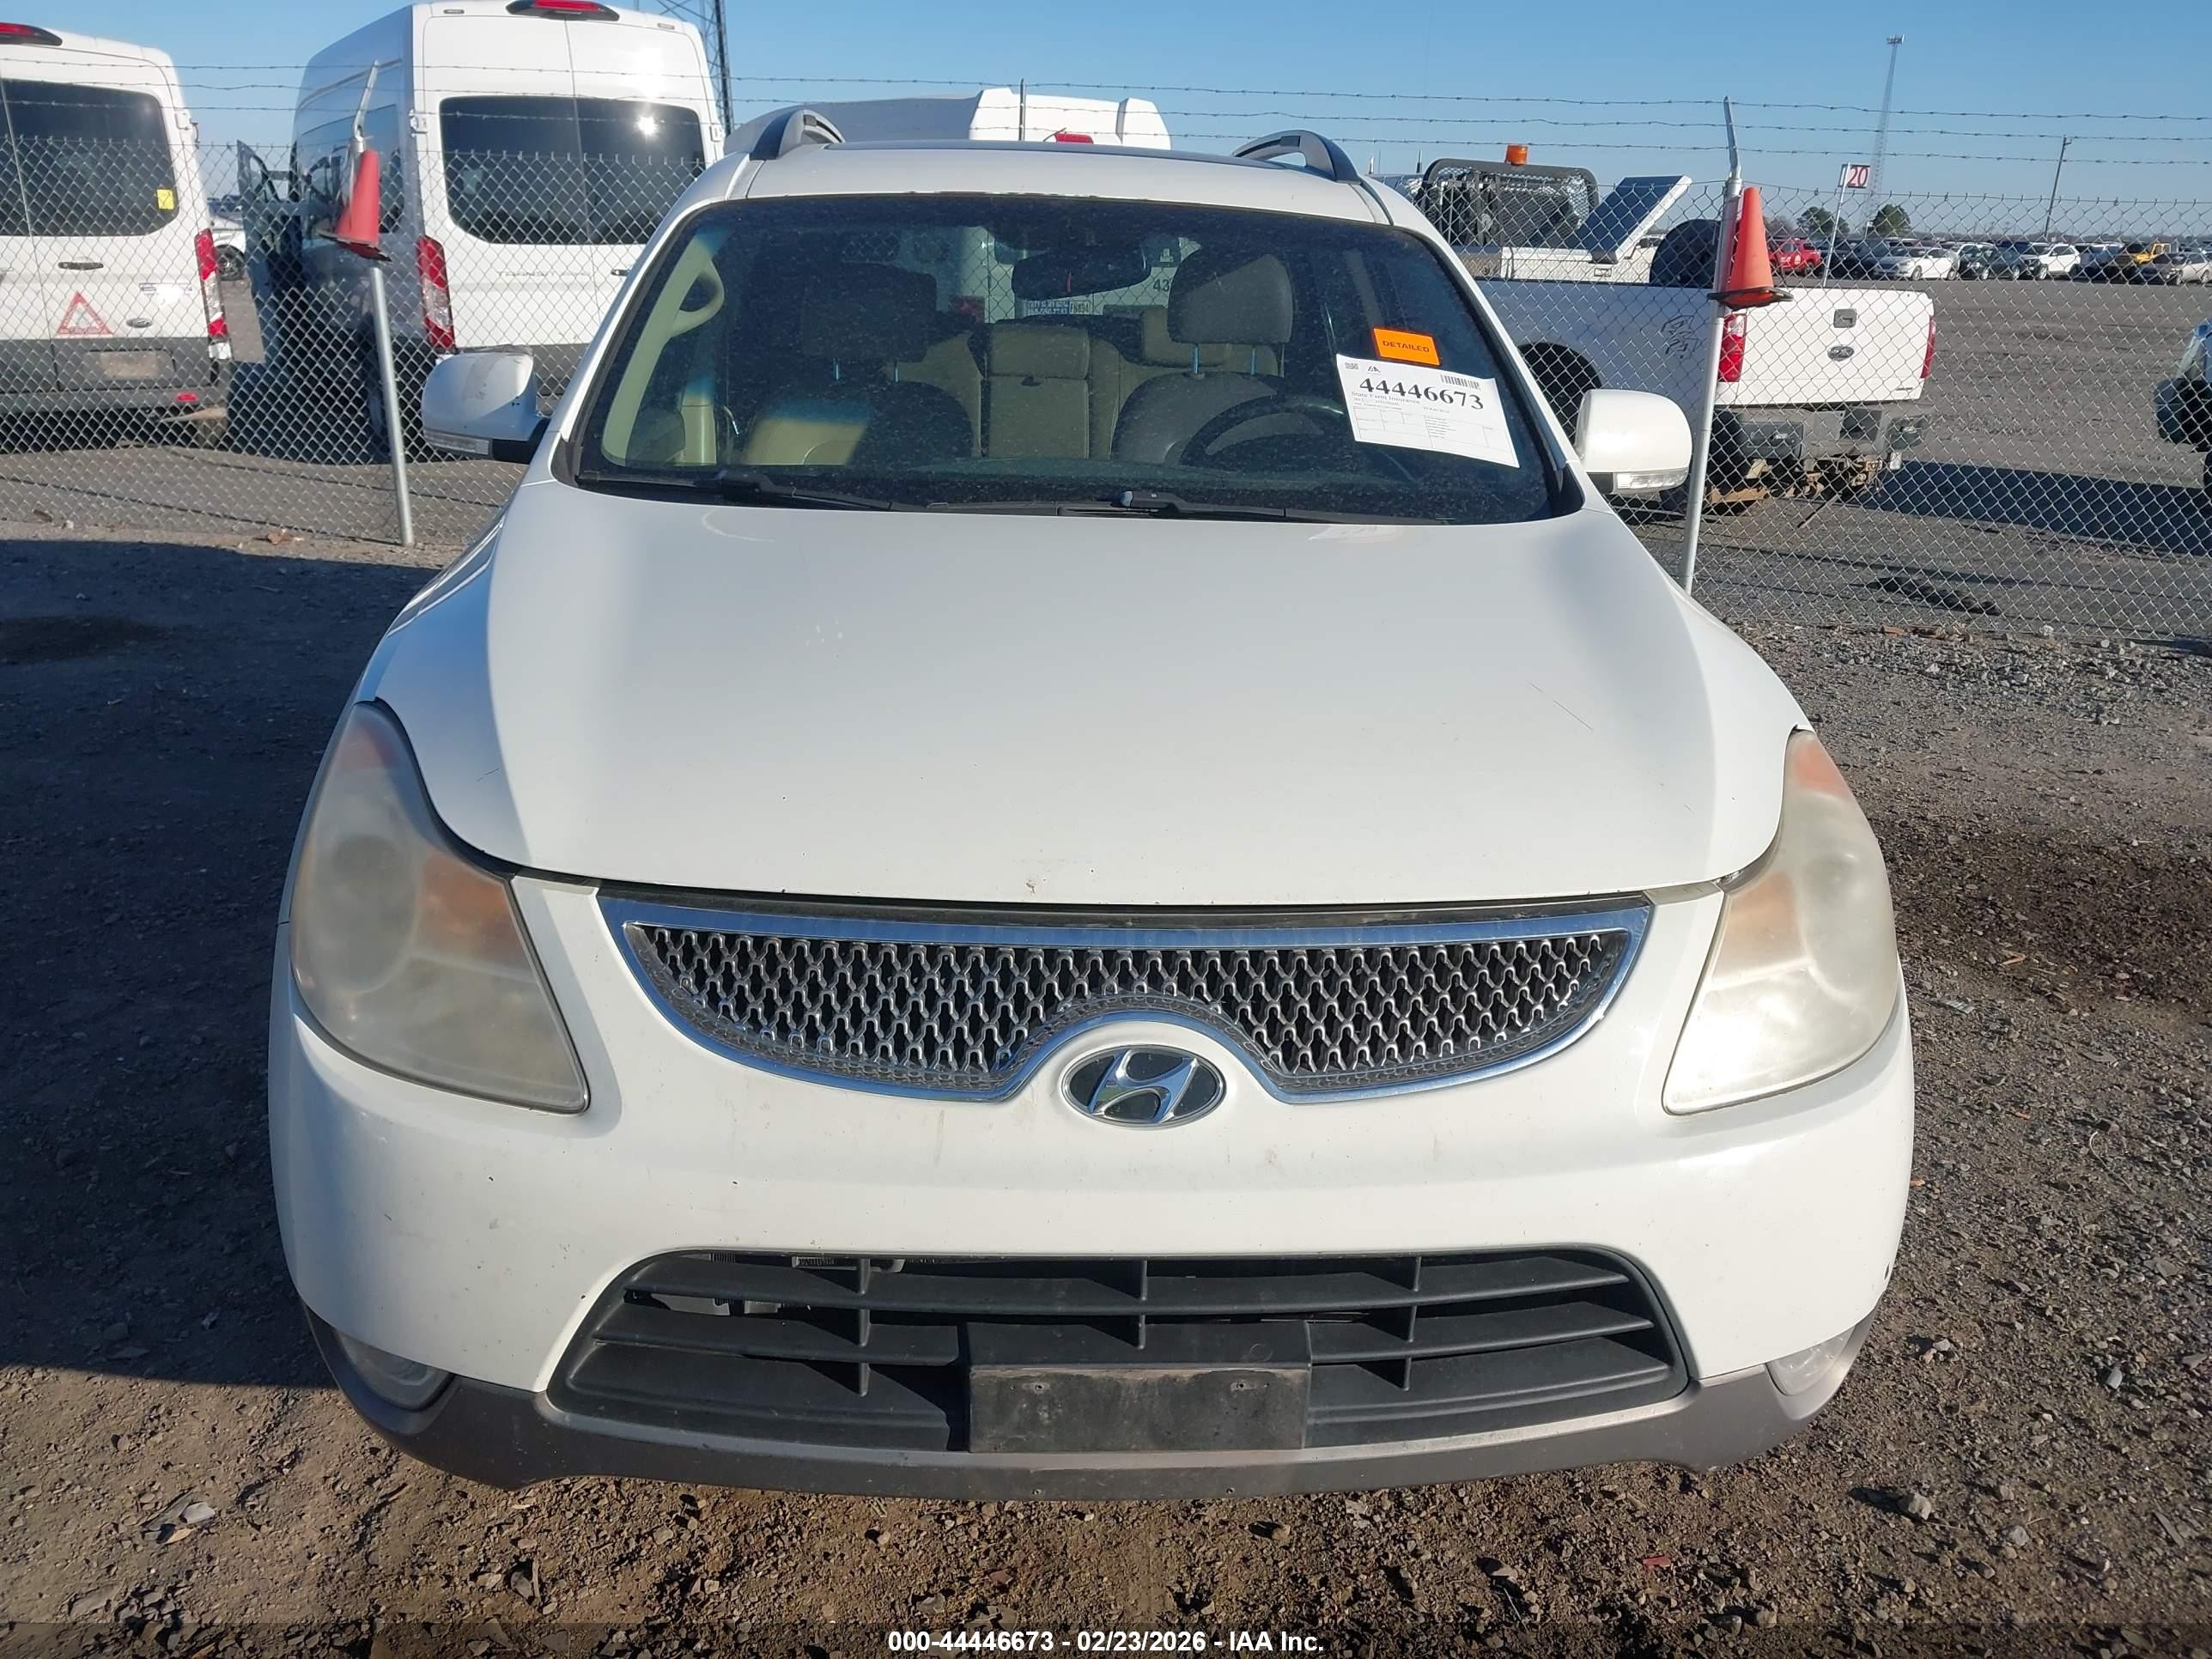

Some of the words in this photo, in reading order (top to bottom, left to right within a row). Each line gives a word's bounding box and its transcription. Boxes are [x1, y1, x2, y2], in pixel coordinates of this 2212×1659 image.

[1847, 166, 1869, 186] 20
[1382, 340, 1430, 353] DETAILED
[1359, 378, 1484, 410] 44446673
